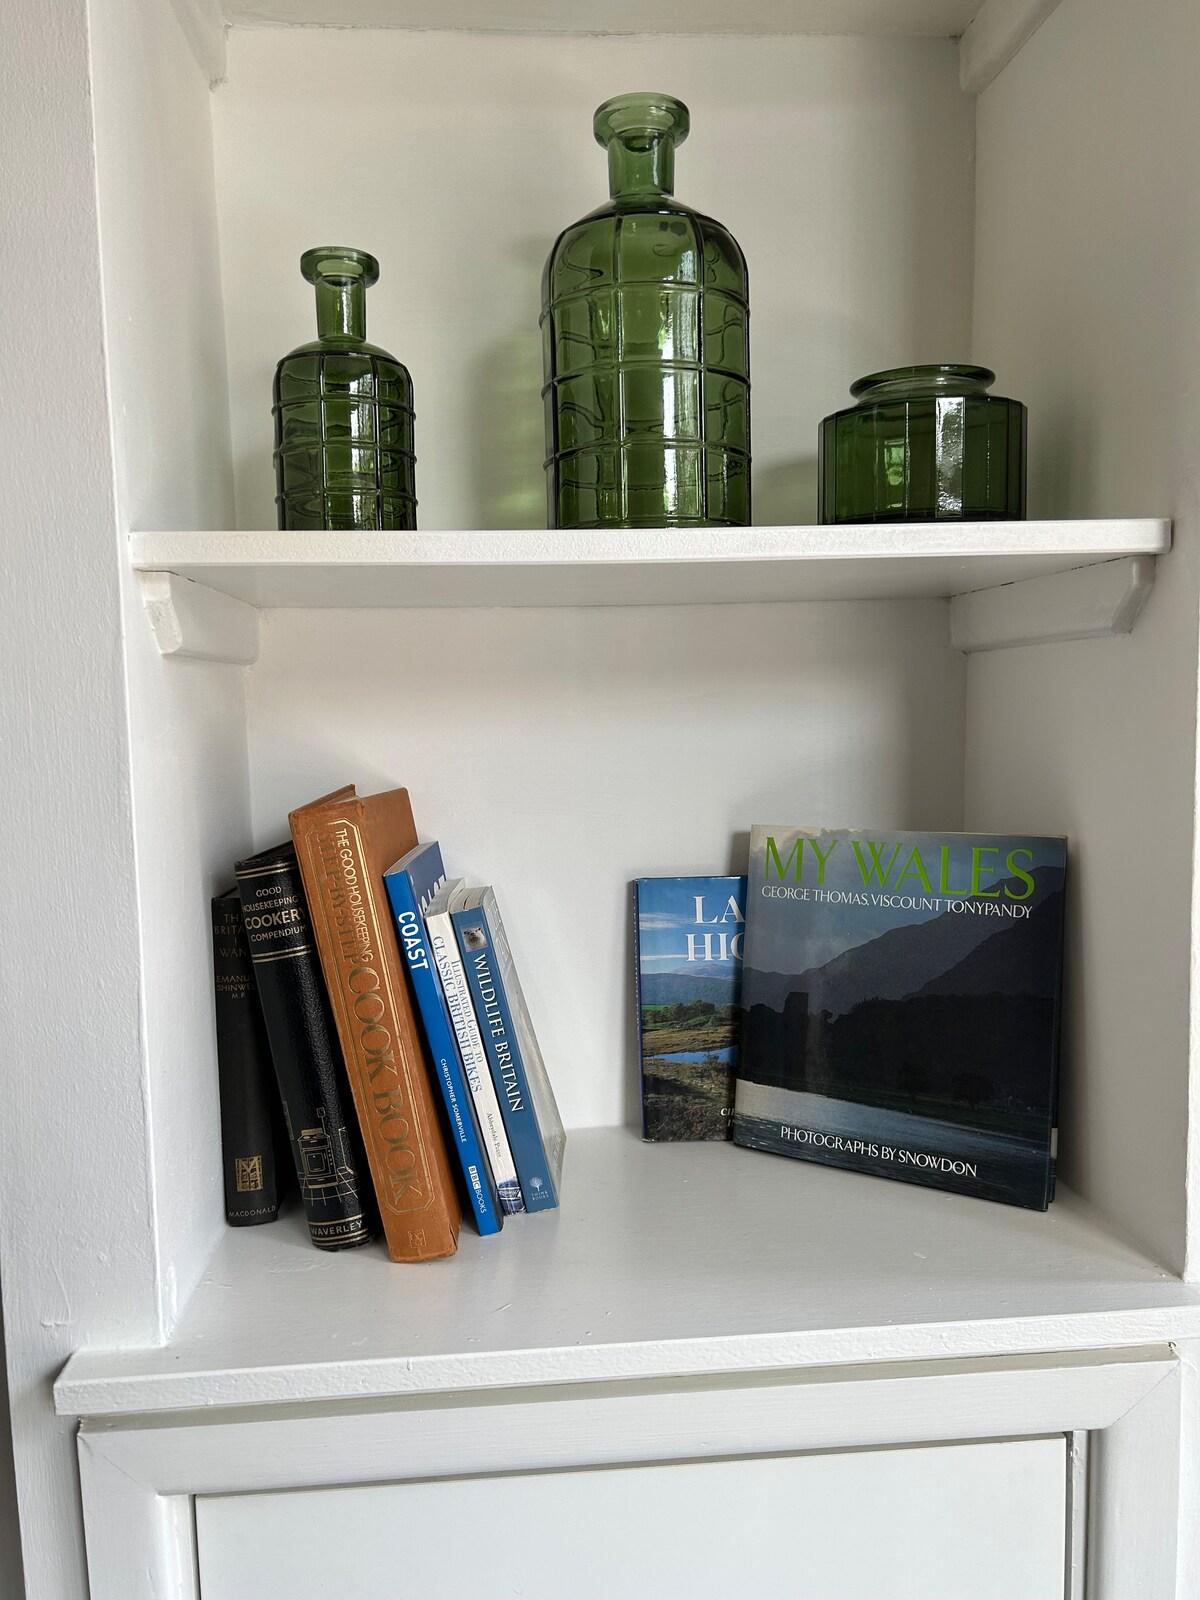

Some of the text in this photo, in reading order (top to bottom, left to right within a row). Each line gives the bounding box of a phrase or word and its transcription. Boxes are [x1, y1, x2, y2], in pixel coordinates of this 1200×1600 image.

[255, 886, 282, 898] GOOD
[335, 828, 374, 963] THE GOOD HOUSEKEEPING
[763, 836, 1036, 901] MY WALES
[761, 885, 811, 902] GEORGE
[870, 893, 942, 913] VISCOUNT
[946, 899, 1034, 920] TONYPANDY
[398, 911, 429, 970] COAST
[432, 936, 483, 1094] CLASSIC BRITISH BIKES
[451, 959, 484, 1063] ILLUSTRATED GUIDE TO
[473, 953, 524, 1113] WILDLIFE BRITAIN
[348, 966, 423, 1206] COOK BOOK
[440, 1058, 468, 1143] CHRISTOPHER SOMERVILLE
[780, 1125, 978, 1178] PHOTOGRAPHS BY SNOWDON
[228, 1205, 276, 1217] MACDONALD
[468, 1165, 487, 1214] BBC BOOKS
[310, 1220, 363, 1237] WAVERLEY
